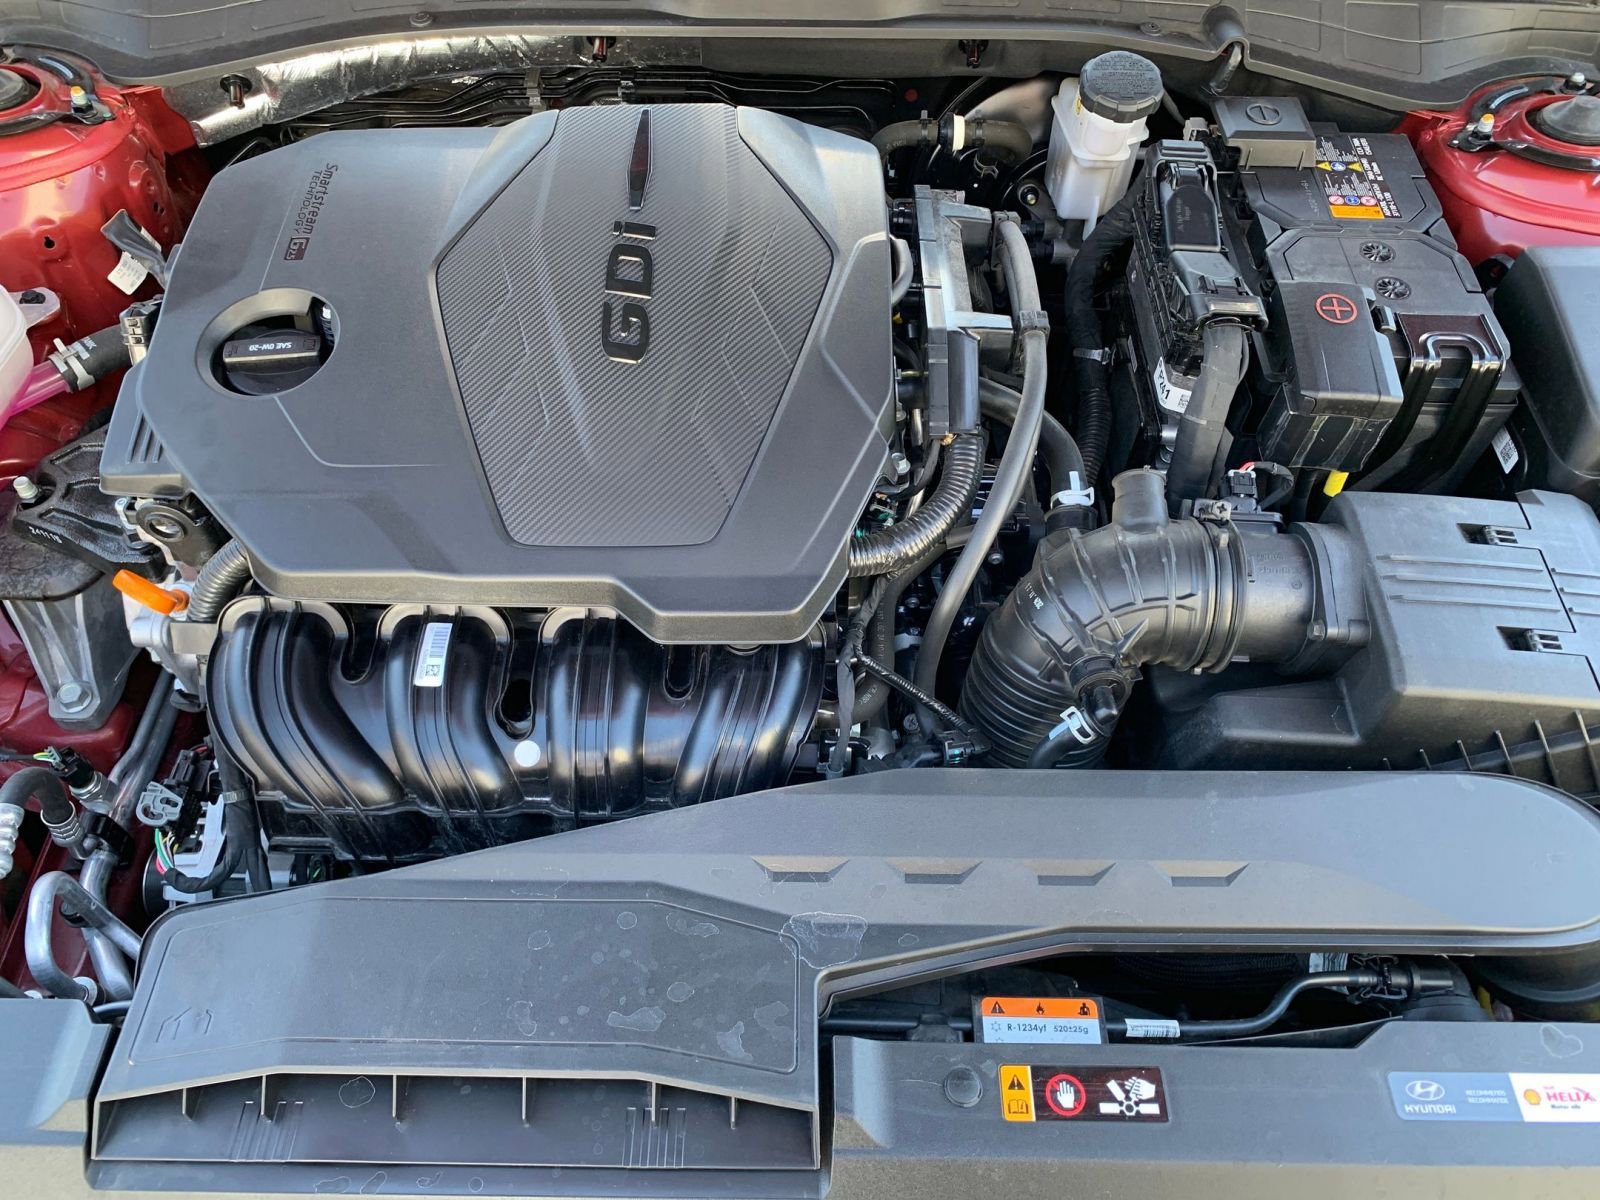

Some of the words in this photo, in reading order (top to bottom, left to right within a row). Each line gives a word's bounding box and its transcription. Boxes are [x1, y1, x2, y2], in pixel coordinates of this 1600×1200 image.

[293, 170, 323, 235] TECHNOLOGY
[303, 162, 339, 235] Smartstream
[602, 220, 657, 364] GDi
[248, 343, 275, 351] 0W-20
[276, 342, 293, 350] SAE
[1007, 1023, 1047, 1033] R-1234yf
[1546, 1089, 1595, 1102] HELIX
[1404, 1103, 1457, 1114] HYUNDAI
